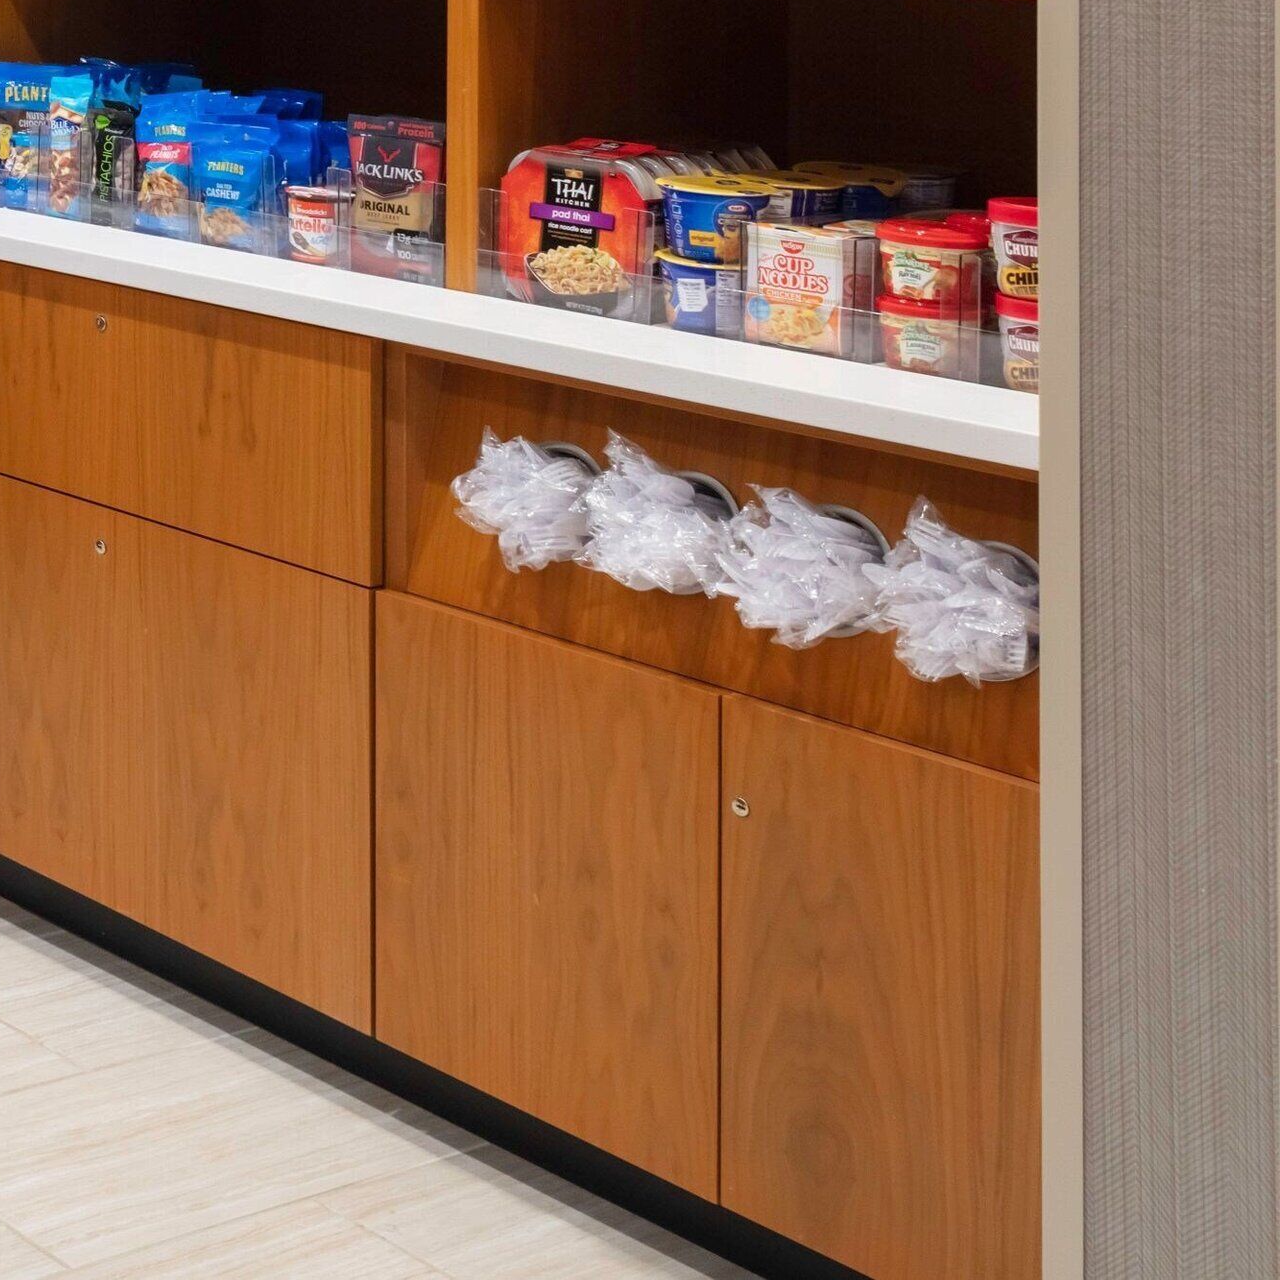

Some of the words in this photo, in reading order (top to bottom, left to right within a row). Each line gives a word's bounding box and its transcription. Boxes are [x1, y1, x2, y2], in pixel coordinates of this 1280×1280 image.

[398, 127, 435, 138] Protein
[150, 149, 180, 159] PEANUTS
[100, 134, 115, 203] PISTACHIOS
[207, 161, 244, 175] PLANTERS
[356, 162, 382, 178] JACK
[384, 165, 423, 182] LINK'S
[206, 188, 240, 200] CASHEWS
[551, 178, 593, 201] THAI
[555, 197, 590, 208] KITCHEN
[551, 210, 570, 220] pad
[572, 211, 590, 222] thai
[560, 223, 579, 232] noodle
[1004, 241, 1038, 257] CHUN
[773, 254, 814, 275] CUP
[758, 266, 828, 294] NOODLES
